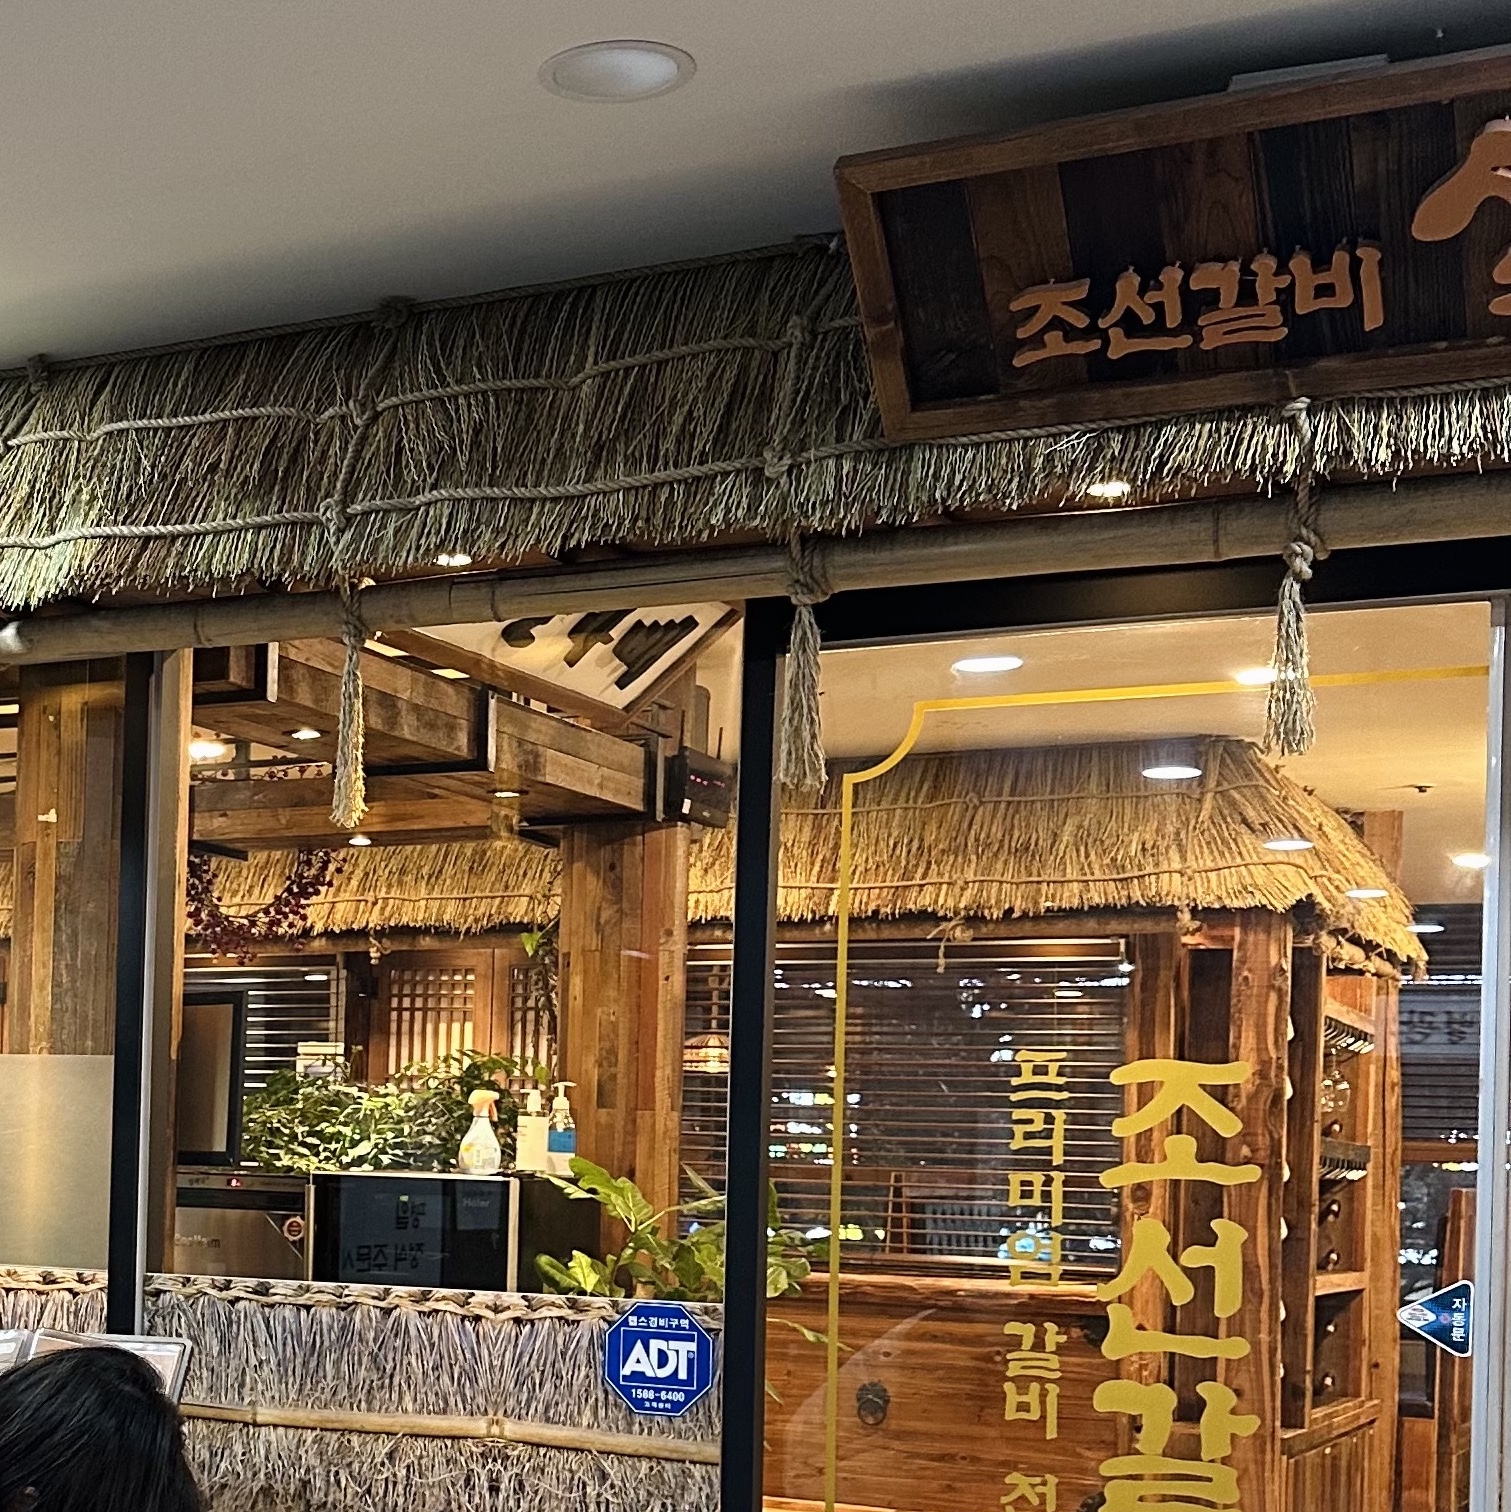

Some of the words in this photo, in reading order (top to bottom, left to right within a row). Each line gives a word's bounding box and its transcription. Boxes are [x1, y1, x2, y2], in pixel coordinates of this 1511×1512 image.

[1009, 239, 1384, 368] 조선갈비
[1007, 1049, 1069, 1287] 프리미엄
[622, 1339, 696, 1380] ADT
[1451, 1297, 1467, 1342] 자동문
[1003, 1321, 1068, 1440] 갈비
